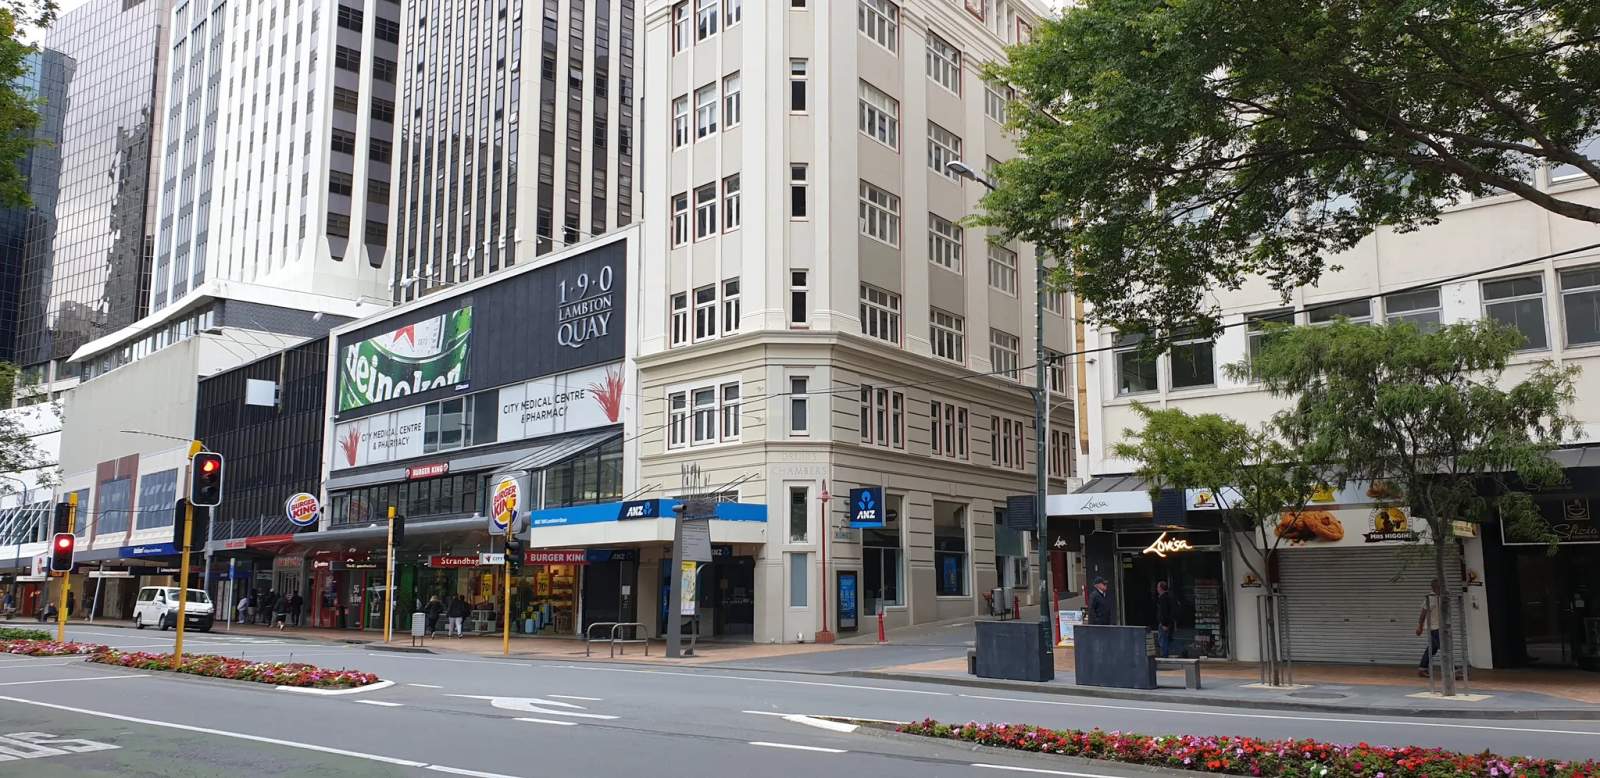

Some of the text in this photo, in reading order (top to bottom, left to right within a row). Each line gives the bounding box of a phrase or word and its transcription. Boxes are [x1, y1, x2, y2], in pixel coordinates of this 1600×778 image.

[559, 294, 612, 320] LAMBTON
[558, 312, 612, 348] QUAY
[503, 389, 585, 414] CITY MEDICAL CENTRE
[526, 406, 568, 422] PHARMACY
[361, 422, 422, 442] CITY MEDICAL CENTRE
[377, 436, 410, 449] PHARMACY
[412, 464, 444, 476] BURGER KING
[494, 485, 517, 503] BURGER
[291, 498, 315, 511] BURGER
[626, 505, 645, 517] ANZ
[1081, 496, 1108, 511] Lovisa
[292, 504, 317, 519] KING
[856, 510, 876, 519] ANZ
[1143, 531, 1193, 557] Lovisa
[441, 556, 480, 567] Strandbag
[530, 553, 564, 562] BURGER
[0, 731, 122, 761] US
